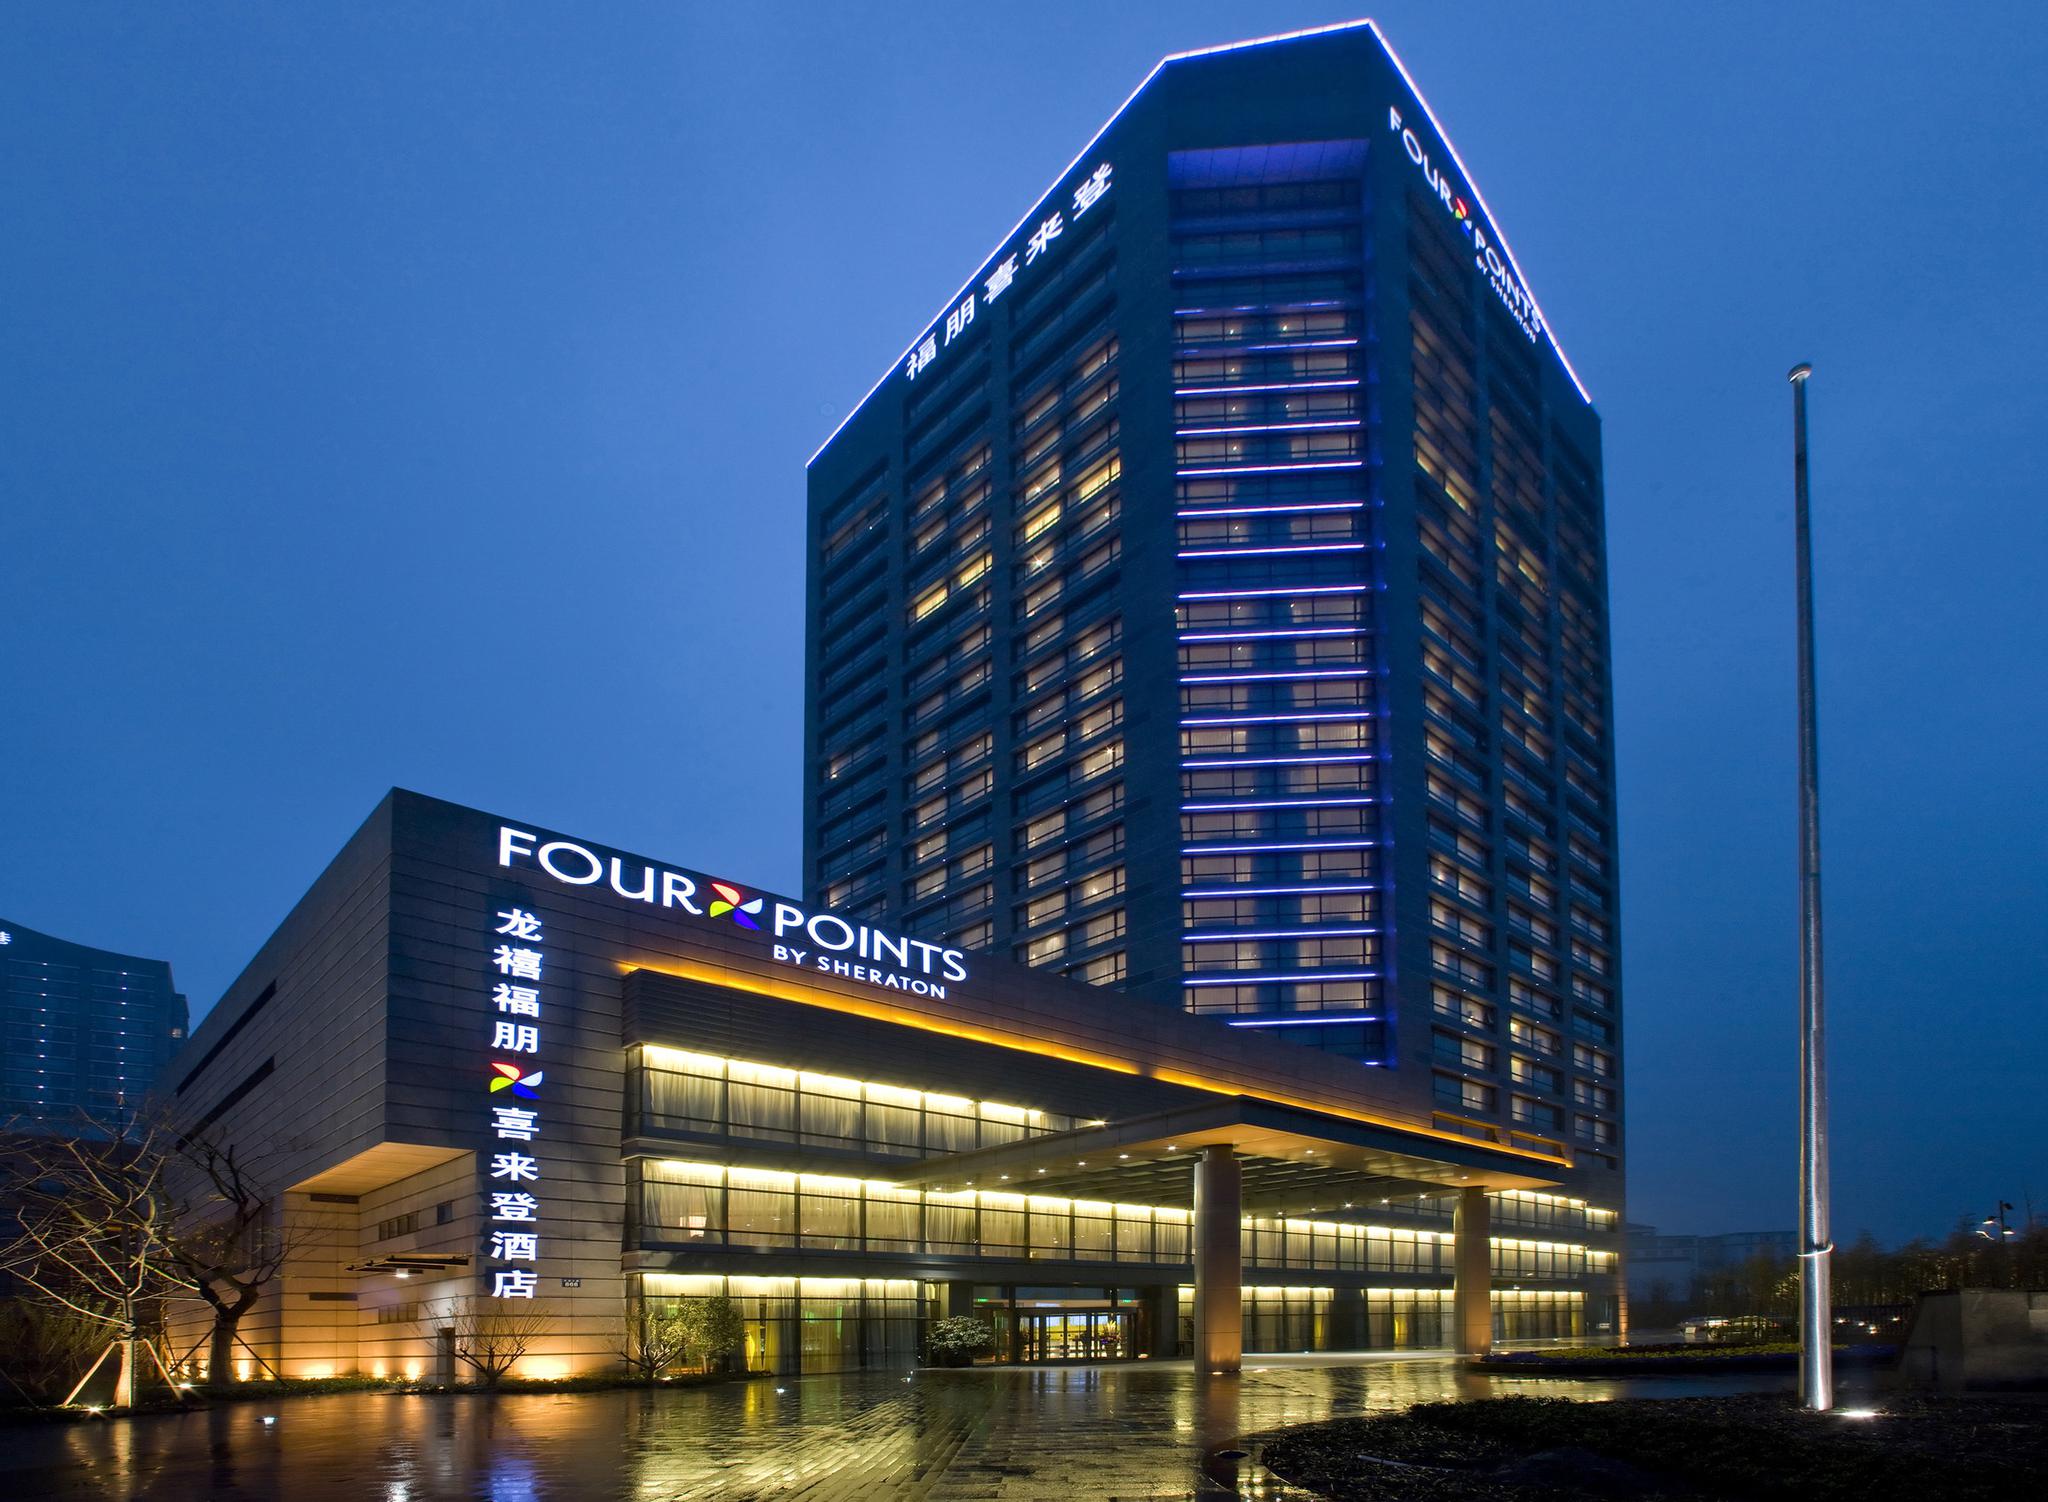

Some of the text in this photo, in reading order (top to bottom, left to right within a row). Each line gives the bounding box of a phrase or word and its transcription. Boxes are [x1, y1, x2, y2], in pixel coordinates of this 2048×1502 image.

[905, 163, 1113, 379] 福朋喜来登
[1390, 106, 1541, 333] FOUR POINTS
[1490, 275, 1537, 344] SHERATON
[498, 826, 967, 982] FOUR POINTS
[773, 944, 945, 1000] BY SHERATON
[490, 908, 543, 1299] 龙禧福朋 喜来登酒店
